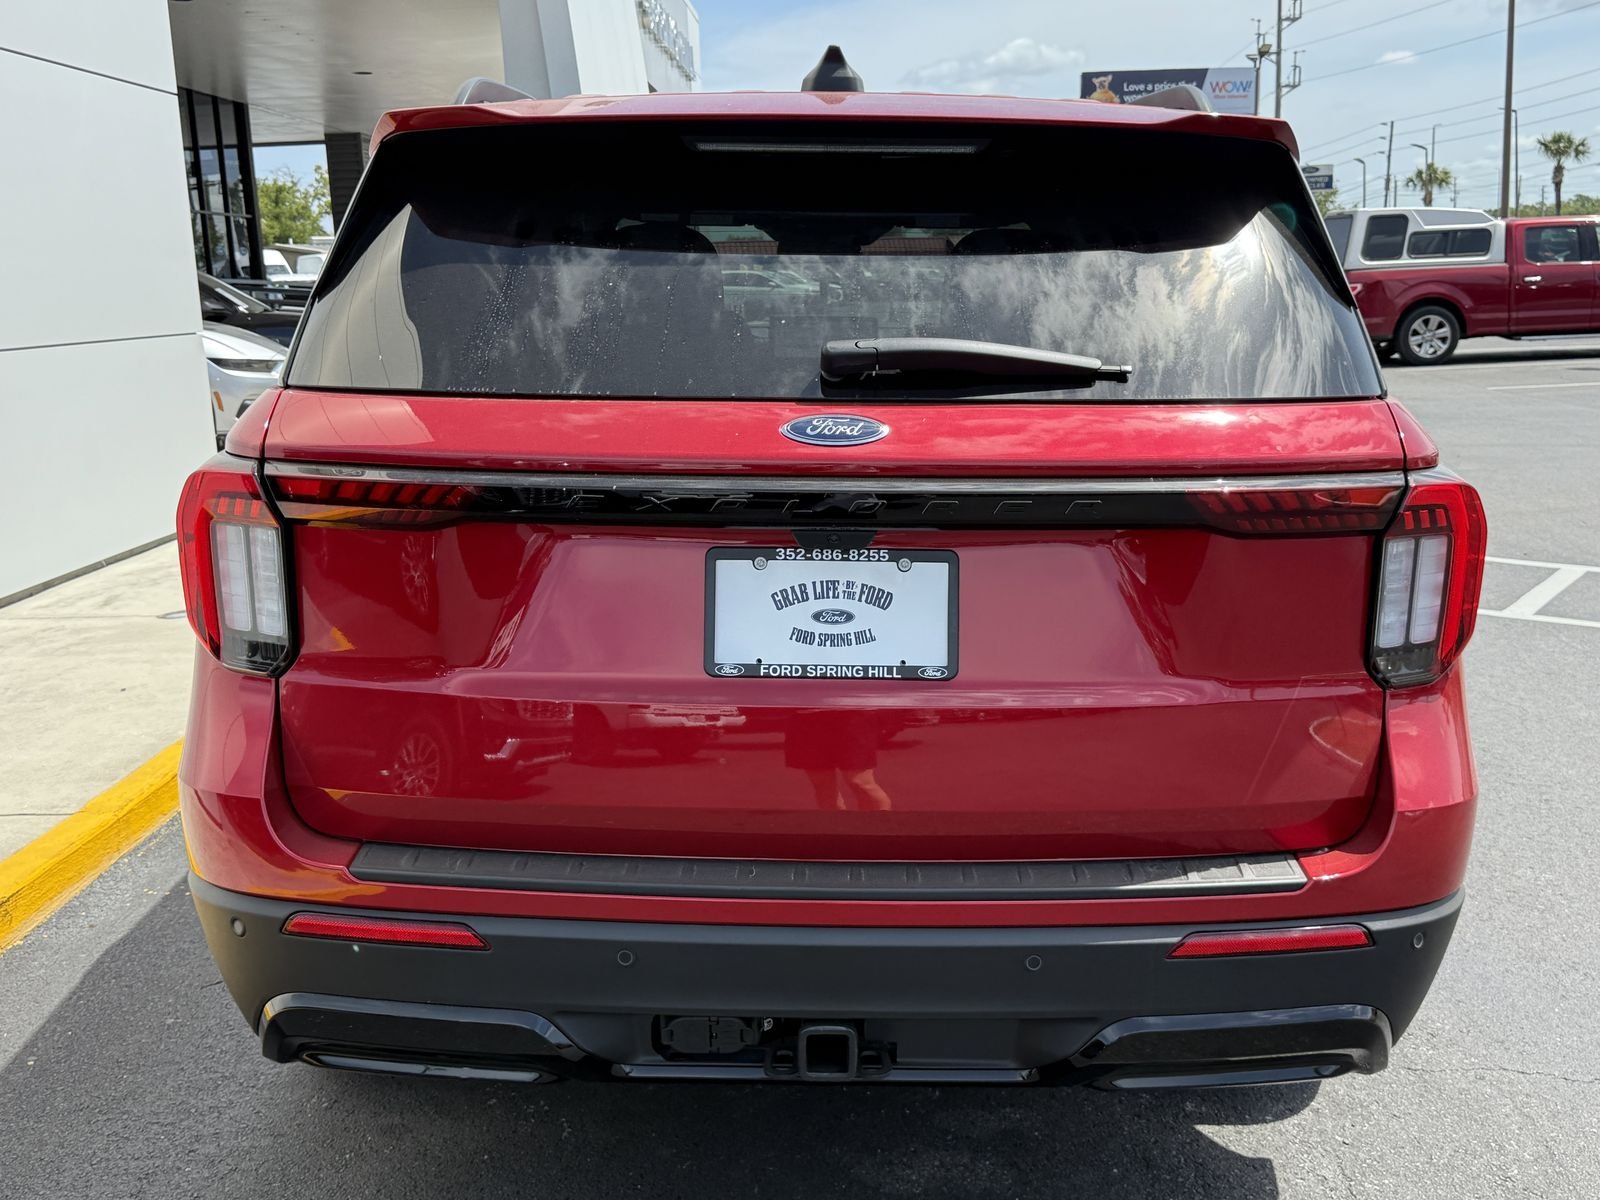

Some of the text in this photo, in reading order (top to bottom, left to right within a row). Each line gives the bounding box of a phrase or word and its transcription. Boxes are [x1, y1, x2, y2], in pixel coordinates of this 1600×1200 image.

[1123, 82, 1145, 92] Love
[806, 418, 864, 436] Ford
[775, 548, 889, 562] 352-686-8255
[770, 579, 894, 611] GRAB LIFE BY THE FORD
[819, 609, 847, 623] Ford
[789, 626, 877, 648] FORD SPRING HILL
[719, 665, 739, 675] Ford
[760, 665, 902, 678] FORD SPRING HILL
[922, 667, 942, 677] Ford
